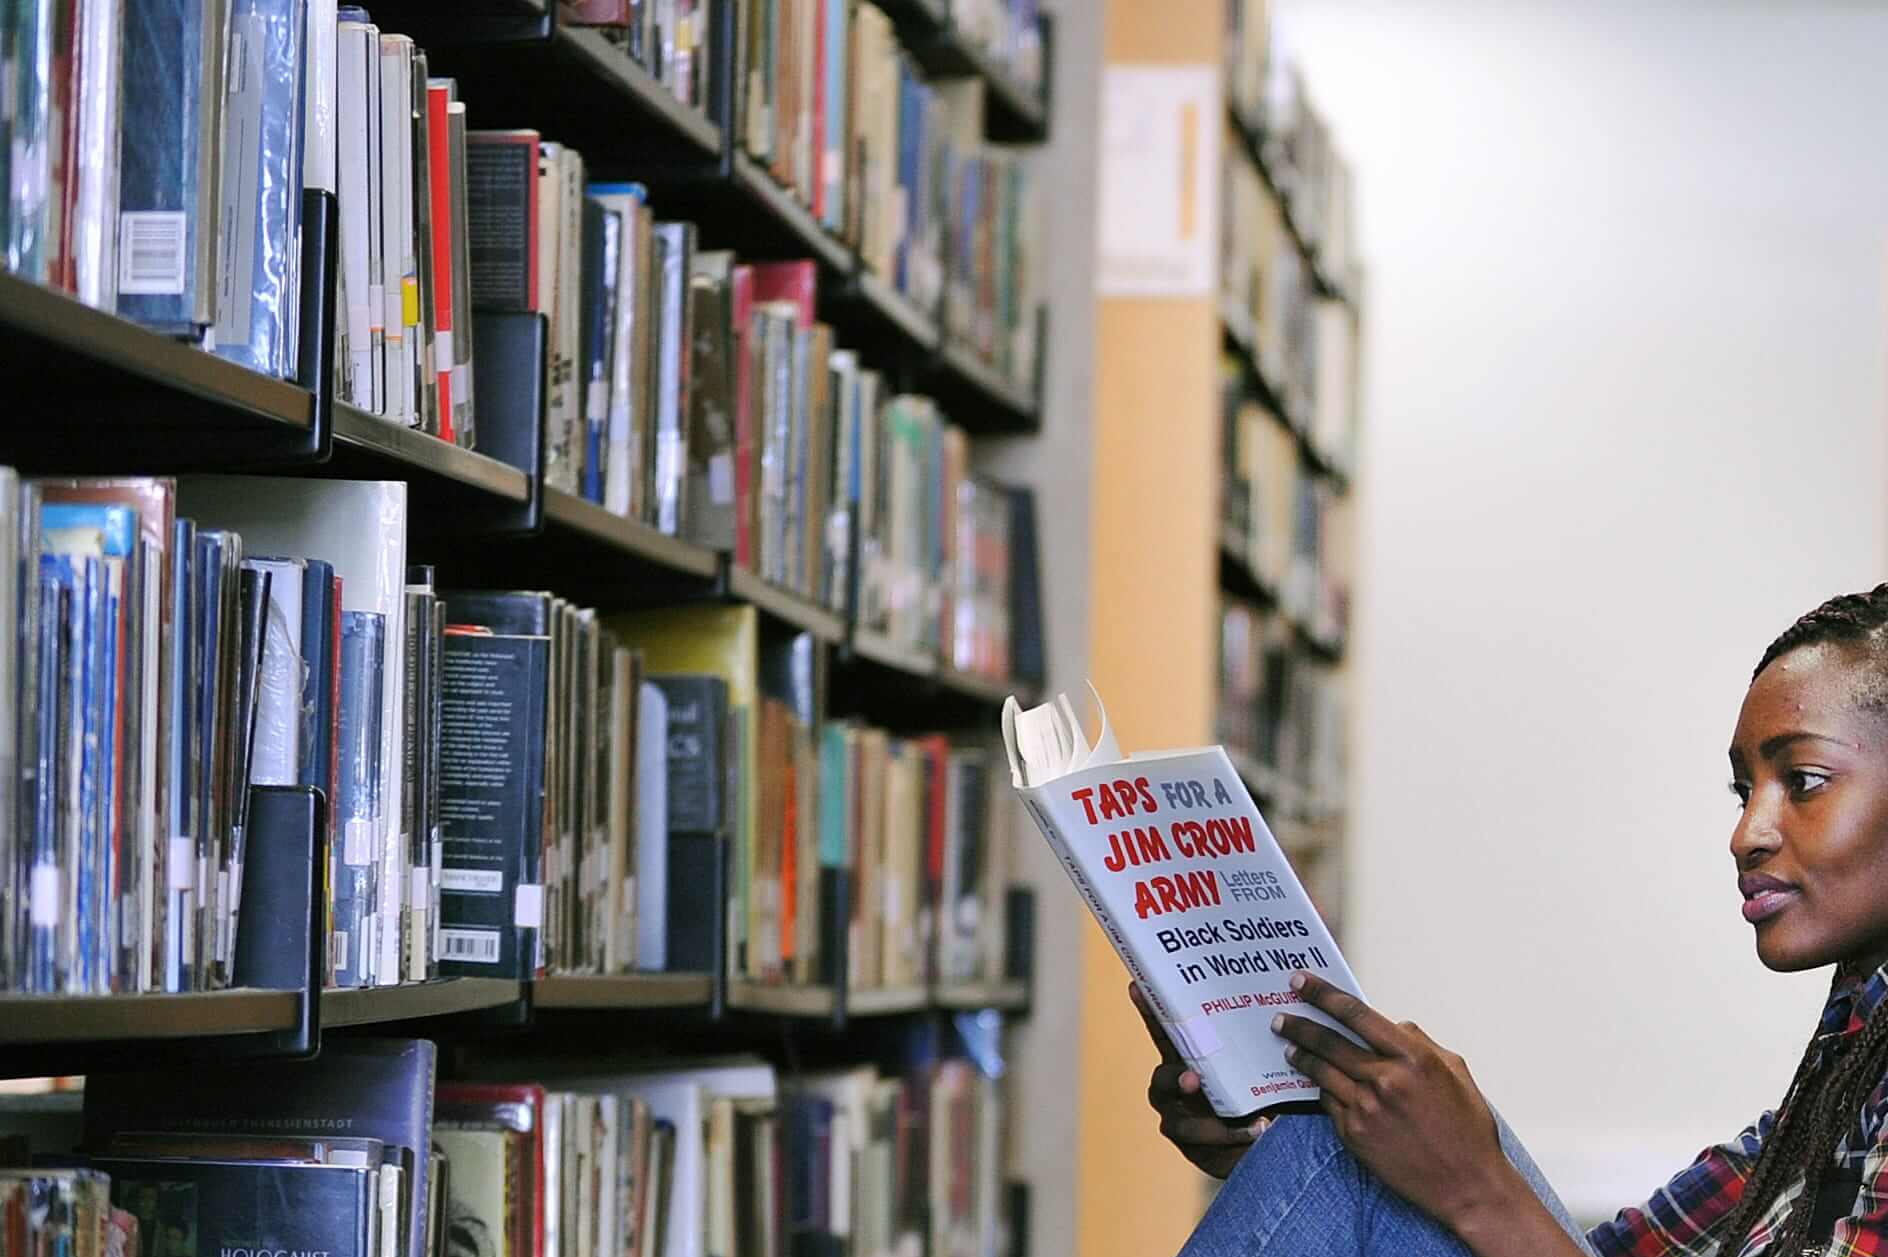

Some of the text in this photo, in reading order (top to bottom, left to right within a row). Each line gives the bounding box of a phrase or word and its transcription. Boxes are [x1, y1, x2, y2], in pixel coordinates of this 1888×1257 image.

[1071, 776, 1158, 825] TAPS
[1160, 780, 1212, 810] FOR
[1213, 777, 1233, 806] A
[1103, 816, 1256, 872] JIM CROW
[1134, 869, 1278, 920] ARMY Letters
[1230, 886, 1287, 903] FROM
[1156, 916, 1309, 954] Black Soldiers
[1176, 946, 1329, 985] in World War II
[1201, 990, 1302, 1016] PHILLIP McGUIR
[1250, 1080, 1297, 1097] Benjamin
